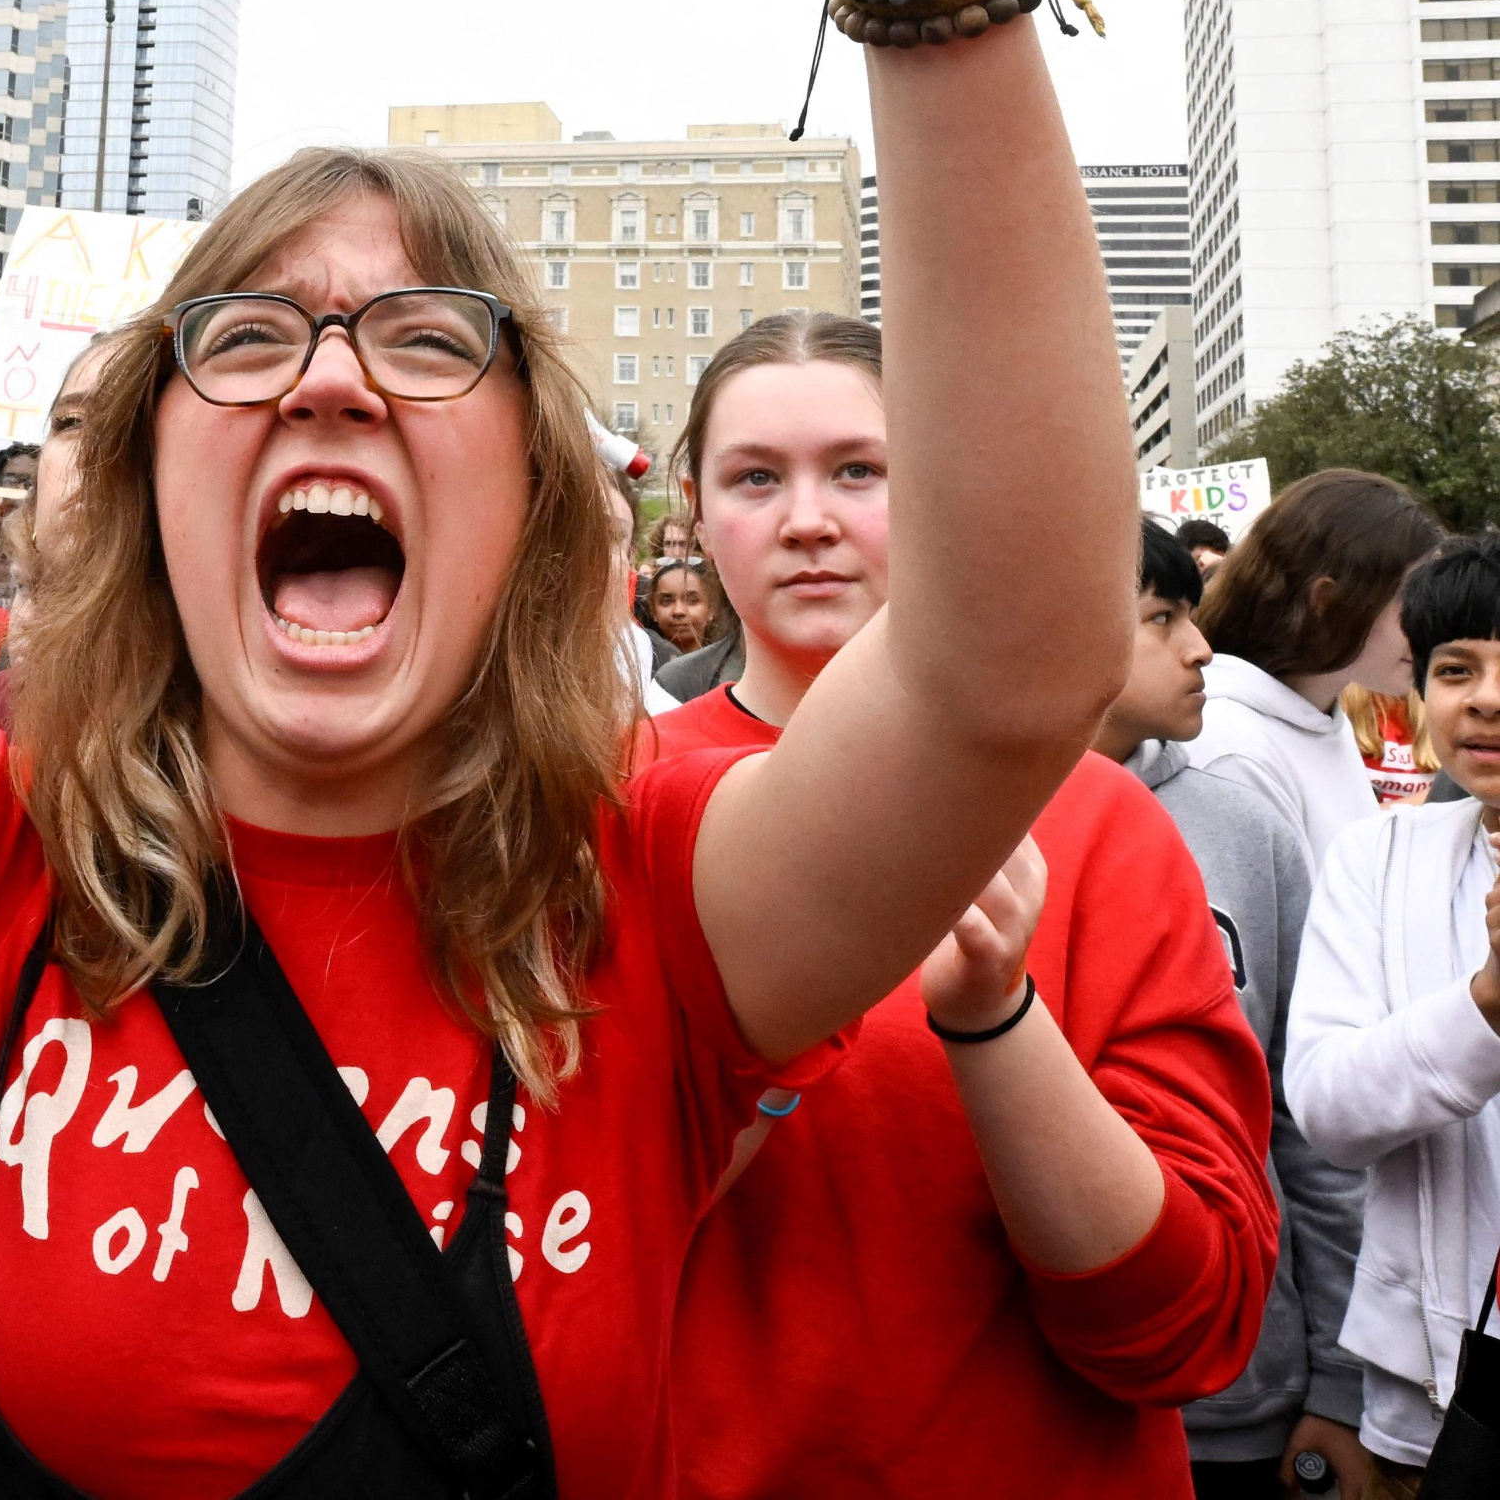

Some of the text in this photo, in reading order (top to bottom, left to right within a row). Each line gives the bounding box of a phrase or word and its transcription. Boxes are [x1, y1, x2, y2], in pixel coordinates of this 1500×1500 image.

[1080, 165, 1182, 177] ISSANCE HOTEL
[1146, 464, 1254, 490] PROTECT
[1170, 483, 1248, 513] KIDS
[92, 1166, 199, 1282] of
